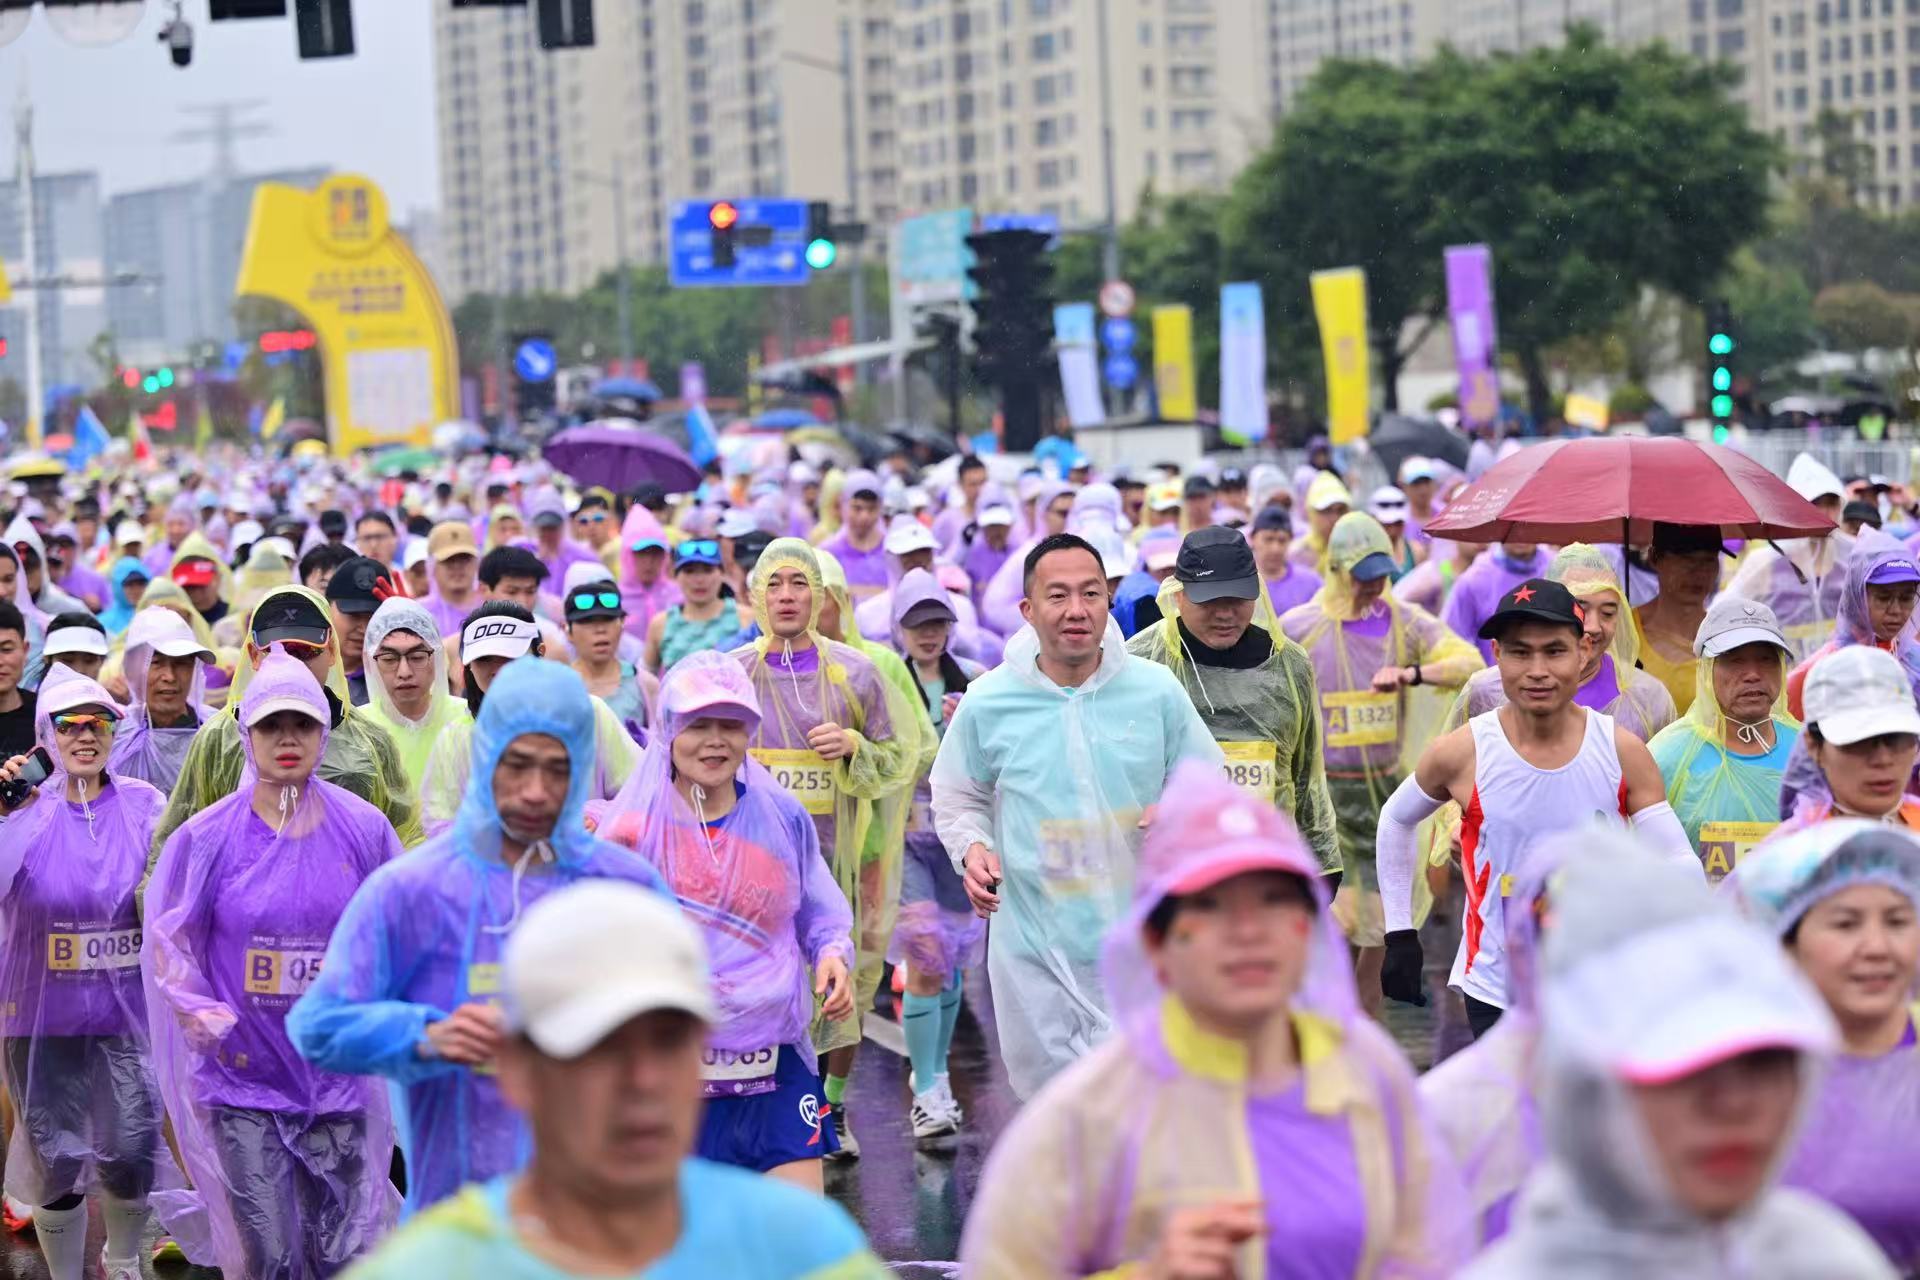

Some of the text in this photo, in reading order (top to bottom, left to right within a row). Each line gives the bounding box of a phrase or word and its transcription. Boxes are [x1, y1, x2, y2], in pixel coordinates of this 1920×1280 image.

[1328, 709, 1345, 728] A
[777, 770, 832, 790] 0255
[1707, 845, 1730, 873] A
[54, 933, 143, 961] B 0089
[252, 954, 273, 981] B
